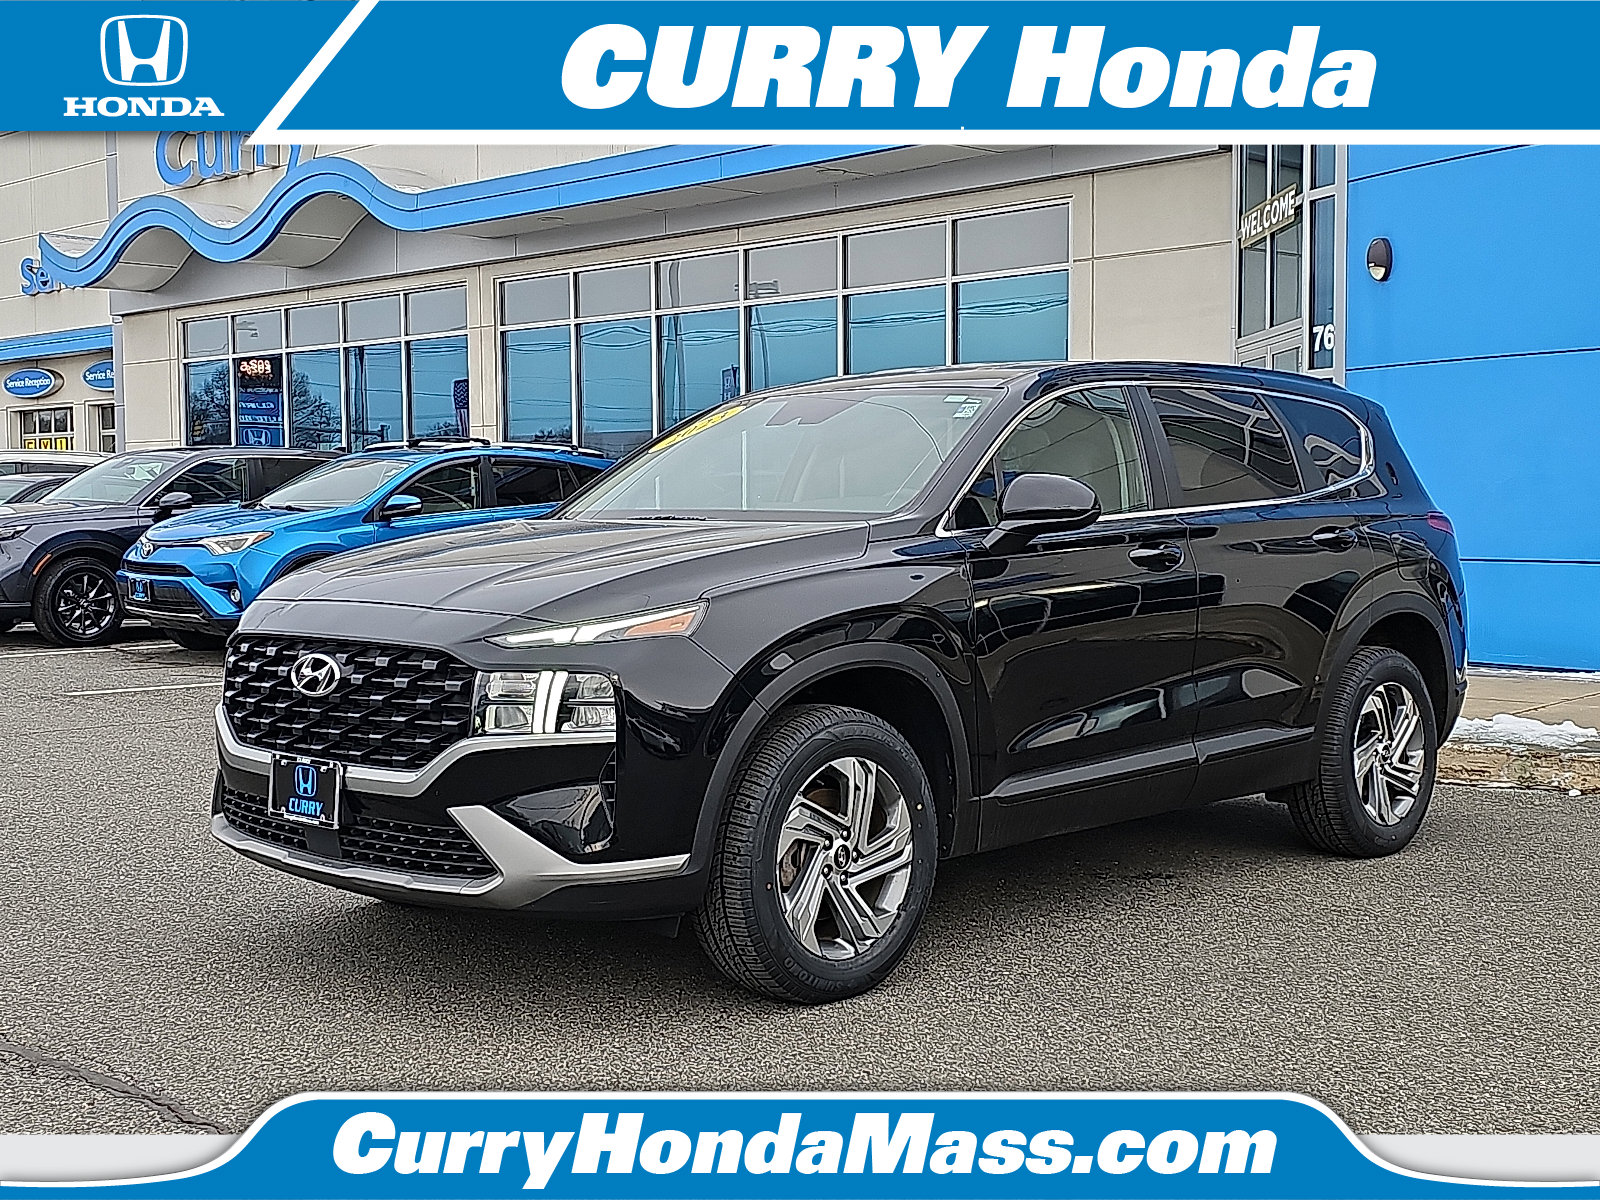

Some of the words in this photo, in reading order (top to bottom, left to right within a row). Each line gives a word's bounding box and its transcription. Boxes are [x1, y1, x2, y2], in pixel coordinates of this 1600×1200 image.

[1241, 189, 1296, 241] WELCOME
[1313, 324, 1335, 352] 76
[288, 797, 324, 817] CURRY
